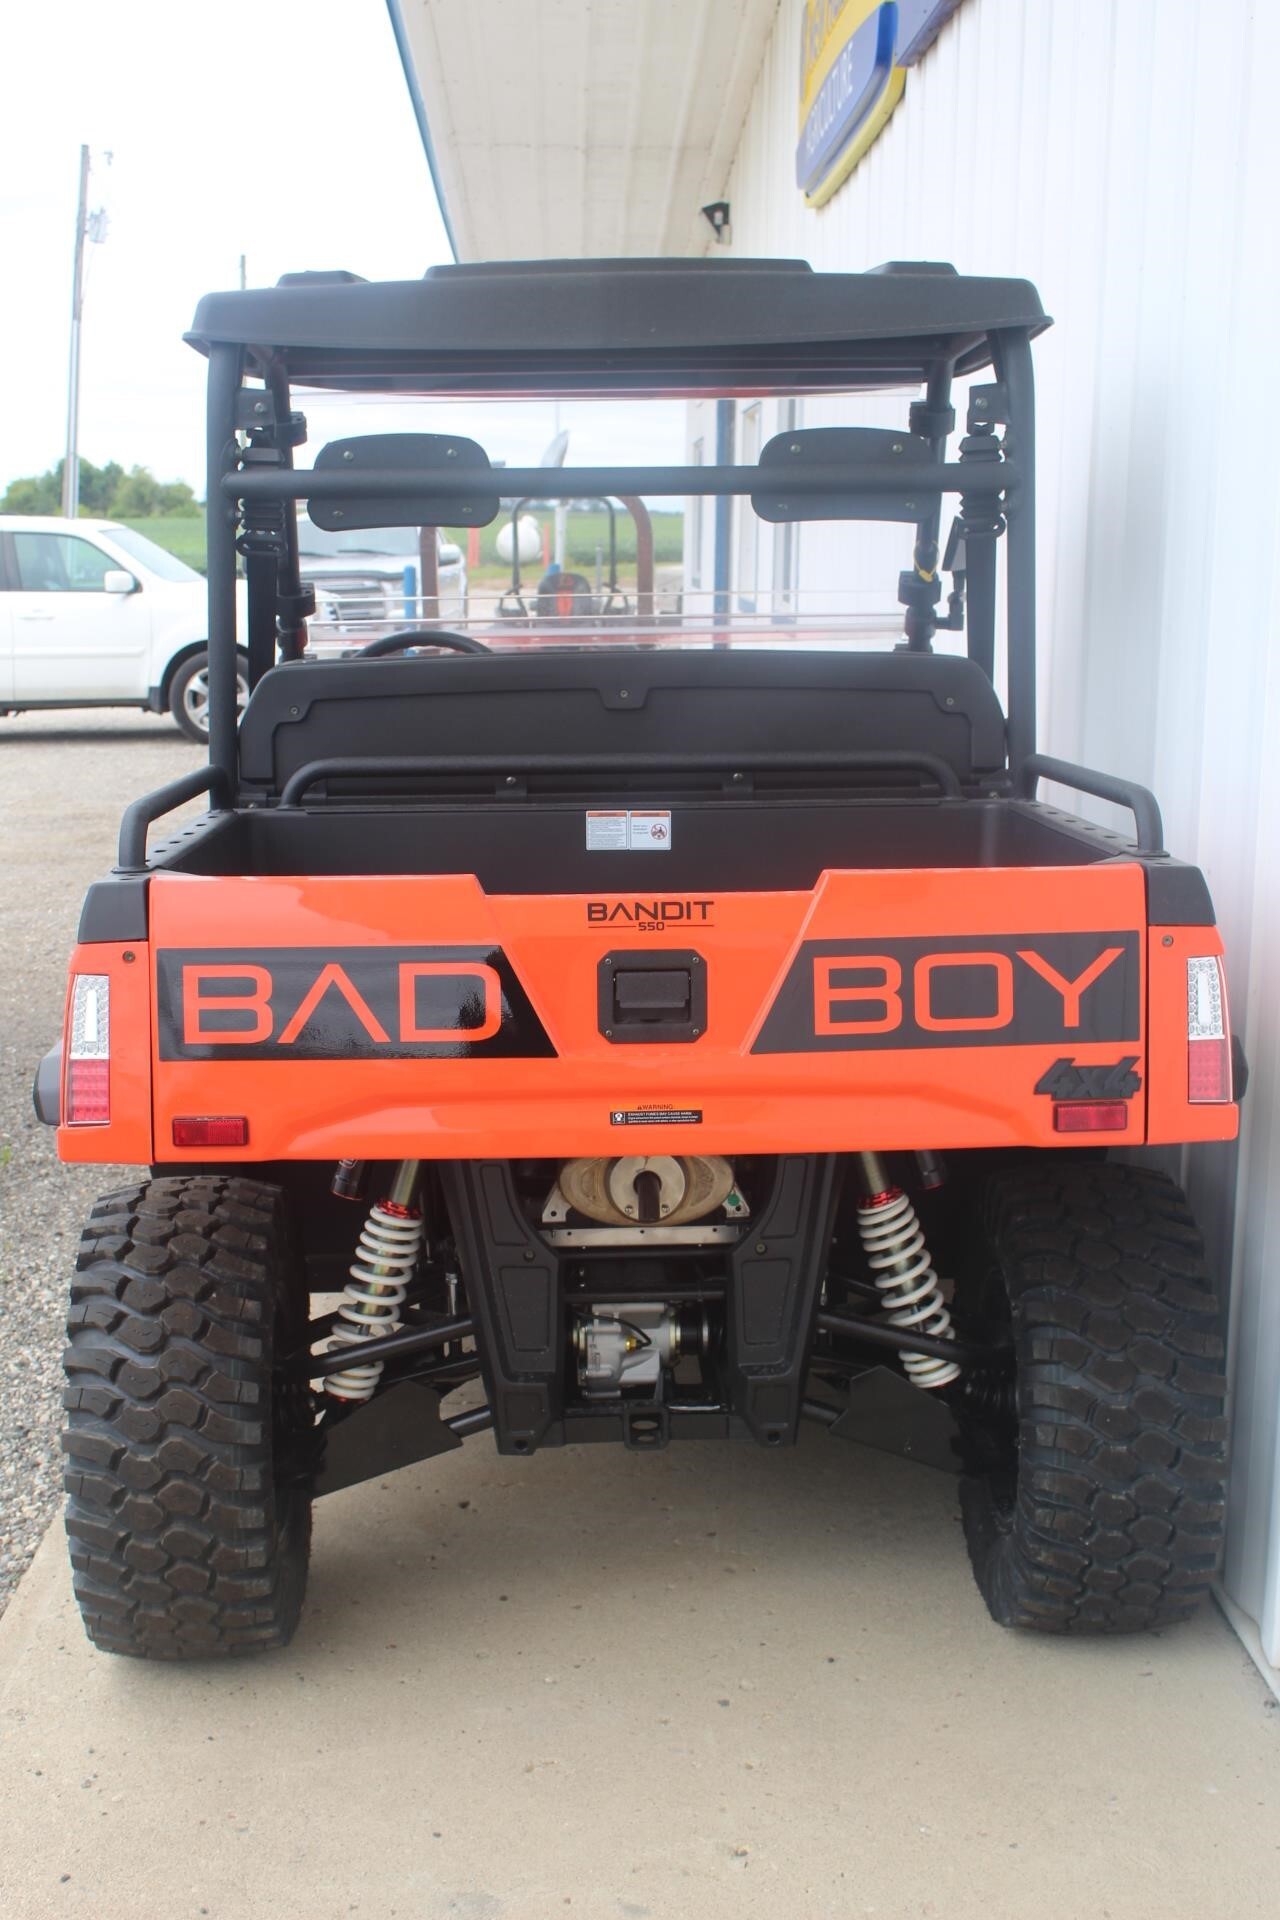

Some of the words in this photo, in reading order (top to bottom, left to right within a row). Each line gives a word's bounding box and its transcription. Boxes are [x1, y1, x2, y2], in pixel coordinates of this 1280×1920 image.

[587, 901, 714, 922] BANDIT
[638, 921, 665, 932] 550
[182, 961, 502, 1044] BAD
[813, 947, 1126, 1036] BOY
